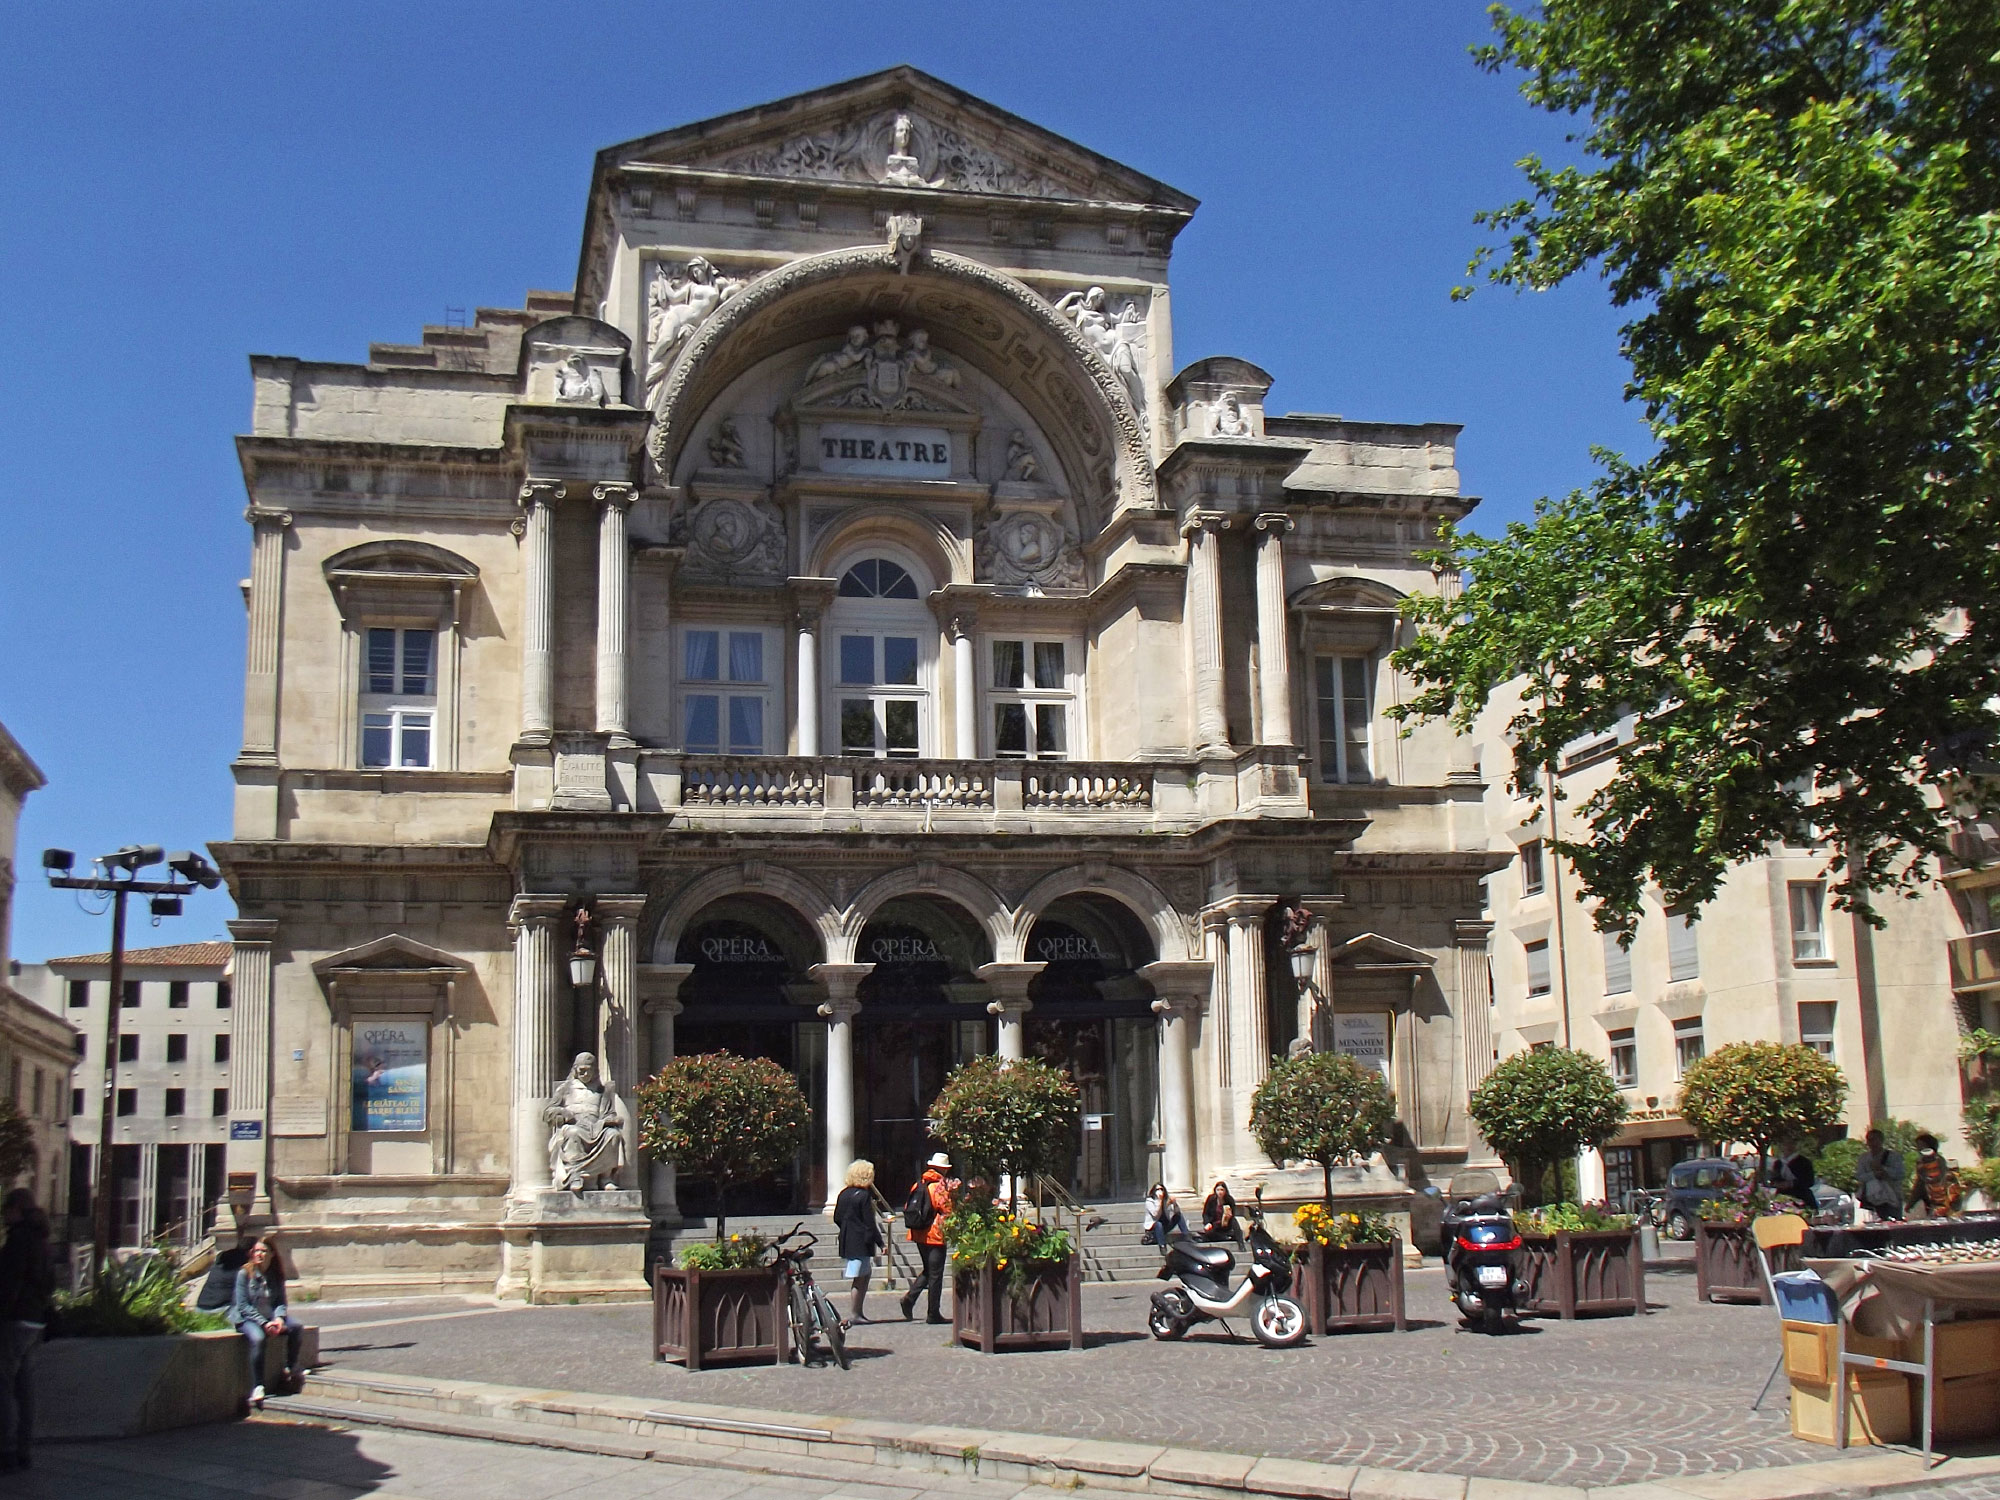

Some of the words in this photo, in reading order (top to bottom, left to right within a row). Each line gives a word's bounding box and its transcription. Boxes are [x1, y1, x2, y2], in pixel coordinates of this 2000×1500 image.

[822, 437, 948, 464] THEATRE
[702, 935, 769, 955] OPÉRA
[872, 936, 937, 955] OPÉRA
[1039, 934, 1101, 953] OPÉRA
[364, 1029, 406, 1042] OPÉRA
[1339, 1039, 1384, 1047] MENAHEM
[1345, 1048, 1384, 1056] PRESSLER
